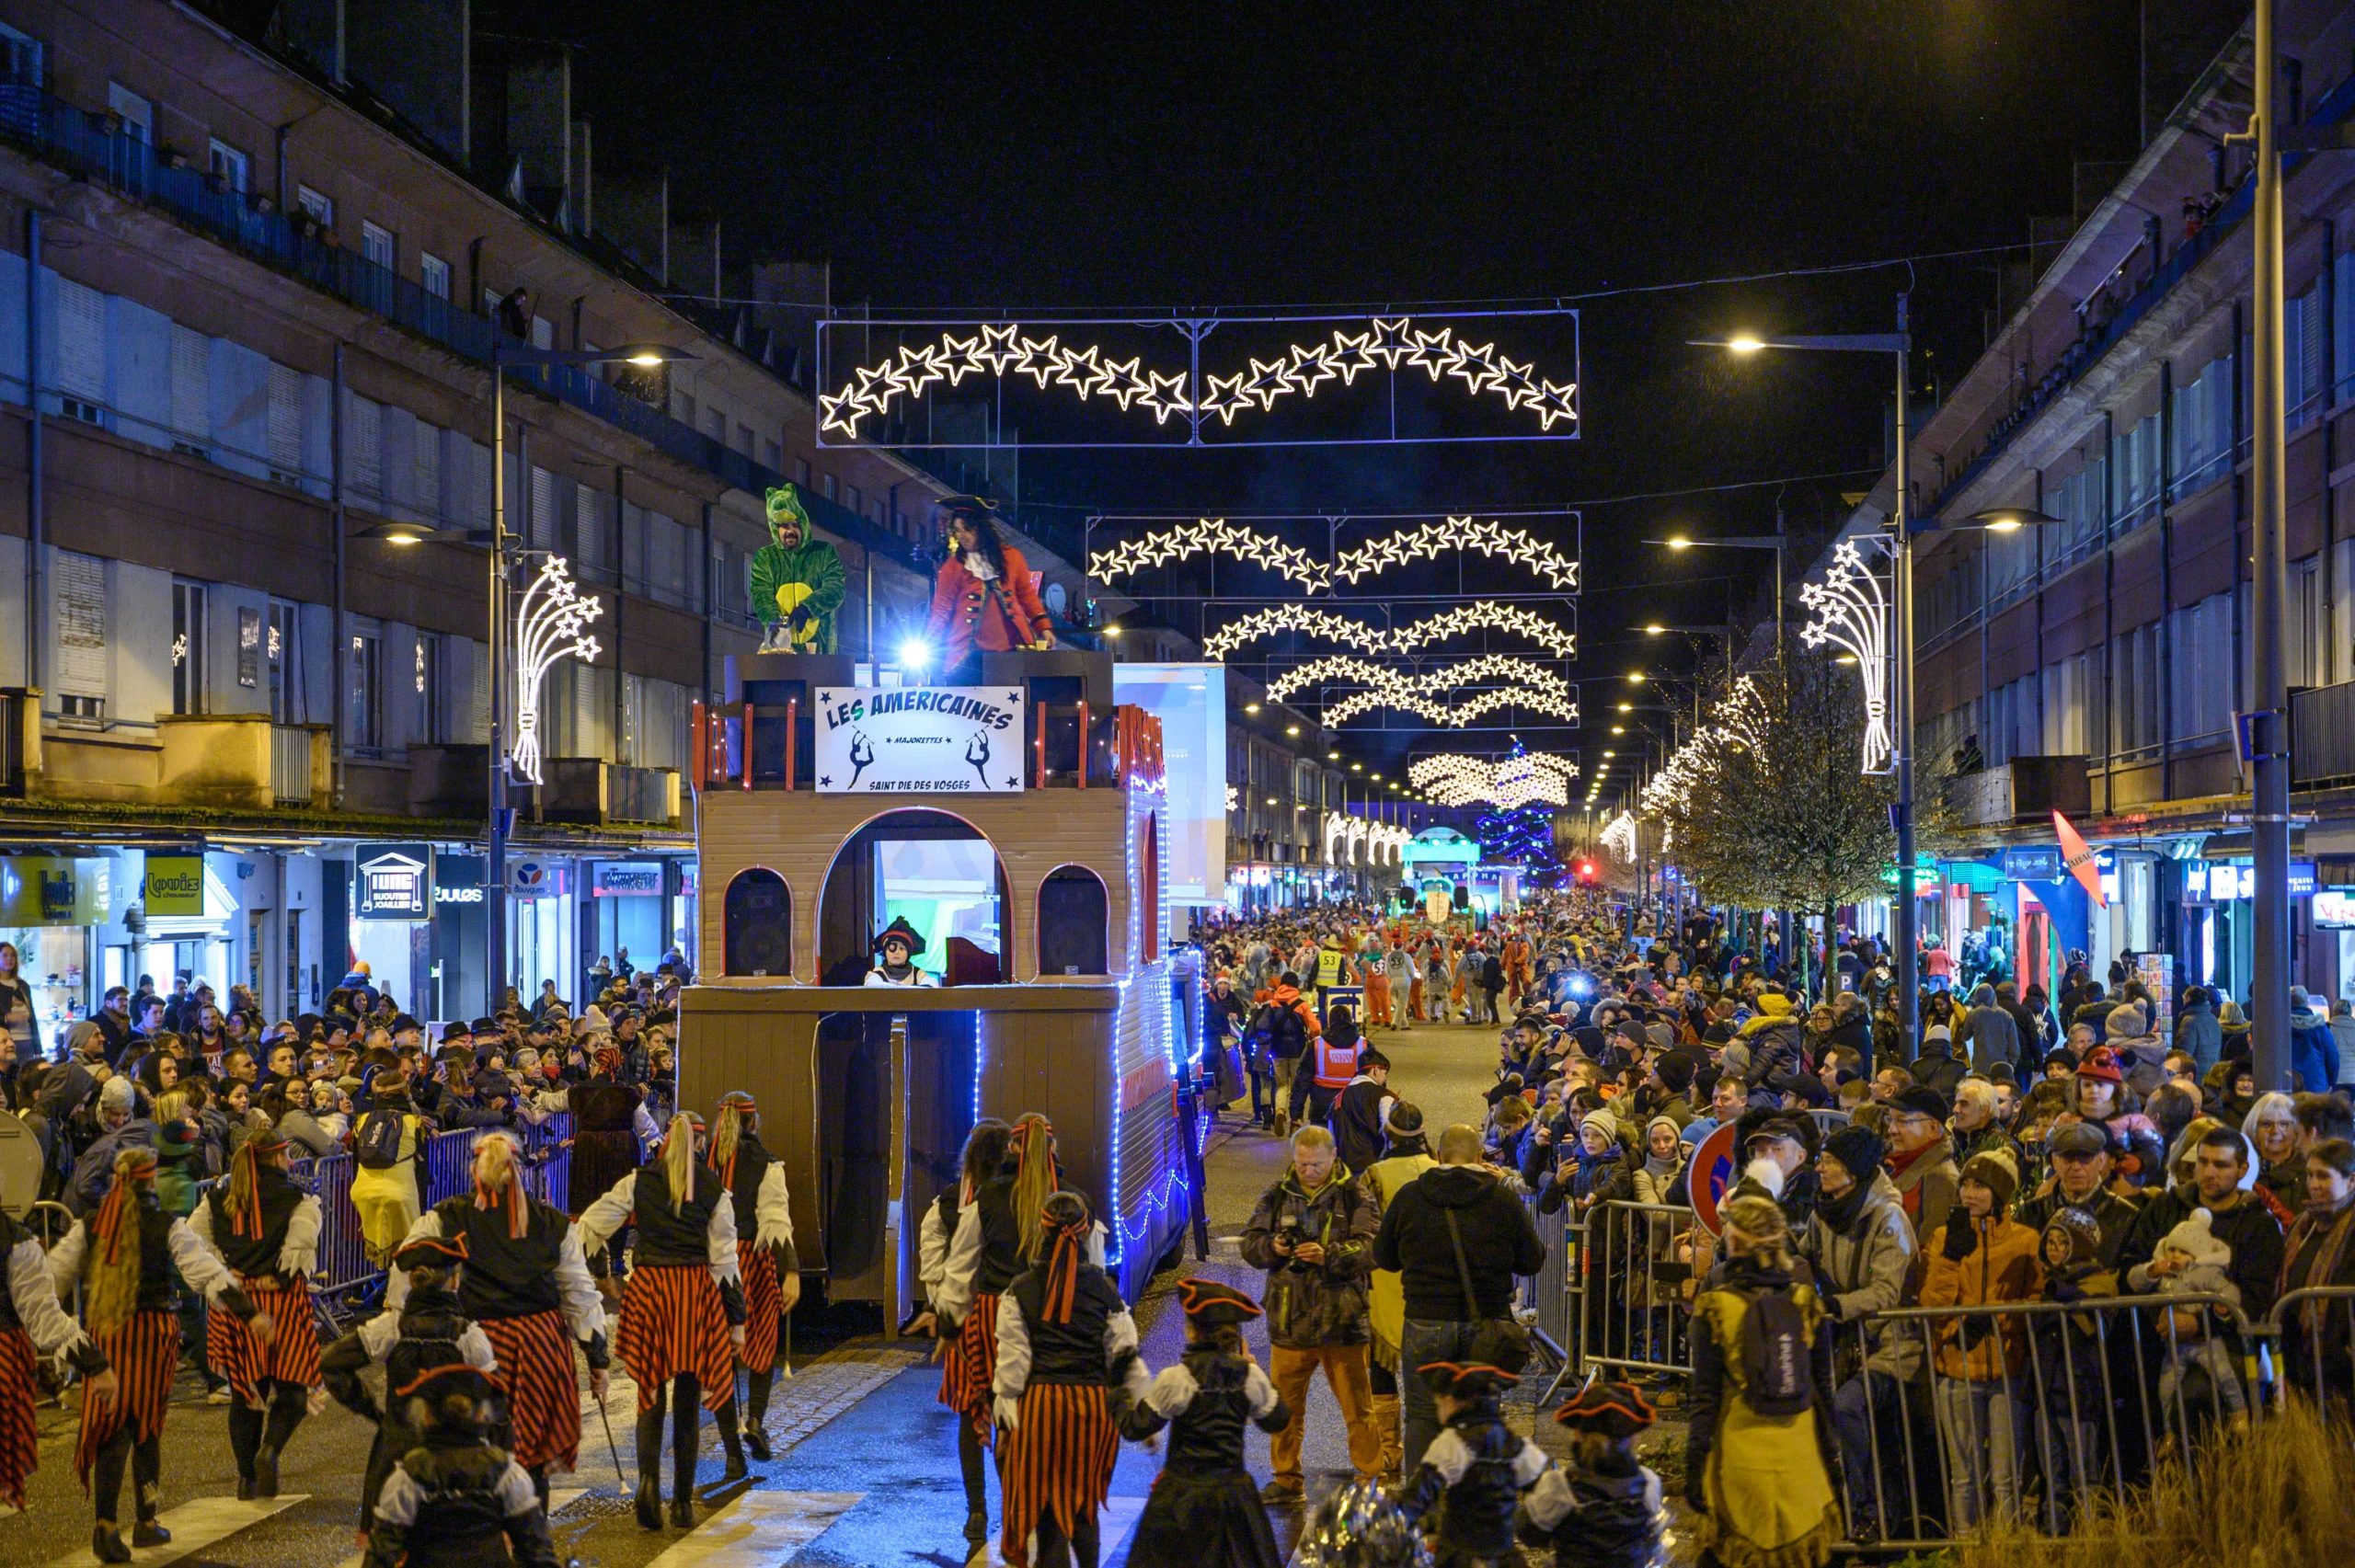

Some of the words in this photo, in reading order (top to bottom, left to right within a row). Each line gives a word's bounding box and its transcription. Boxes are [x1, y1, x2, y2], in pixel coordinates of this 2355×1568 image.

[827, 699, 864, 730] LES
[870, 691, 1014, 730] AMERICAINES
[869, 781, 895, 791] SAINT
[898, 781, 912, 790] DIE
[913, 781, 931, 790] DES
[934, 780, 970, 790] VOSGES
[373, 892, 410, 900] BIJOUTIER
[1323, 956, 1336, 966] 53
[1390, 957, 1403, 967] 53
[1468, 958, 1483, 971] 53
[1374, 962, 1385, 974] 53
[1842, 976, 1851, 990] P
